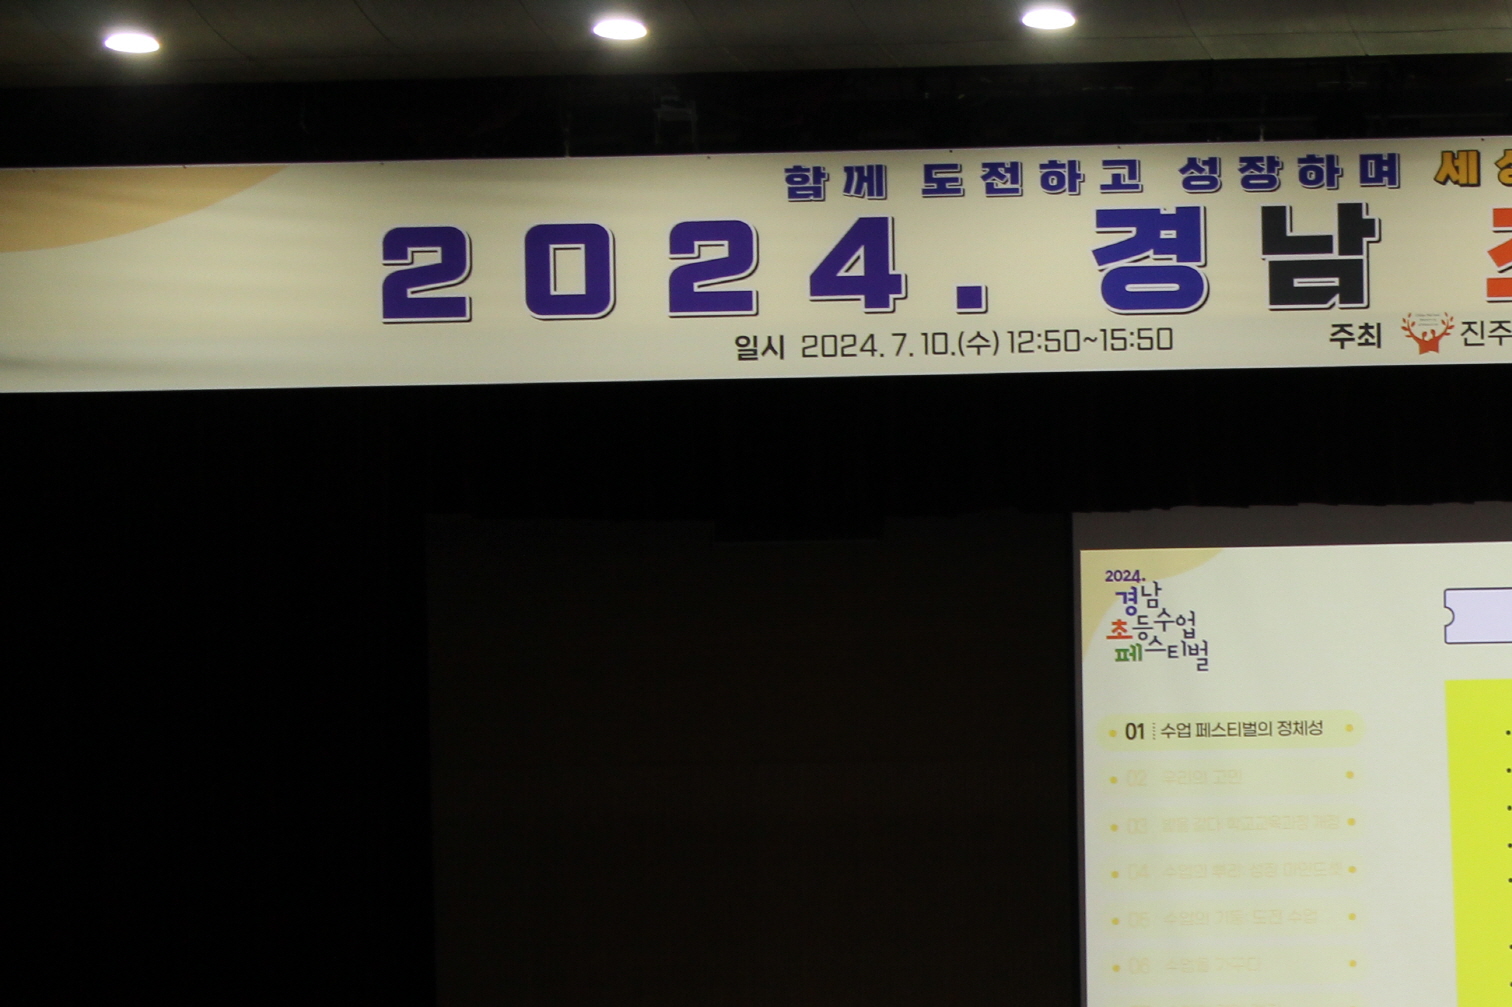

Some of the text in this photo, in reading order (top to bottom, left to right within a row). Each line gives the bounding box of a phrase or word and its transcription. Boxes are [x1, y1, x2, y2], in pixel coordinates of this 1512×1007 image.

[784, 164, 887, 202] 함께
[922, 159, 1143, 198] 도전하고
[1179, 153, 1400, 194] 성장하며
[382, 217, 988, 324] 2024.
[1092, 203, 1382, 315] 경남
[735, 335, 784, 361] 일시
[1007, 328, 1173, 353] 12:50~15:50
[1330, 323, 1381, 349] 주최
[1105, 569, 1146, 583] 2024.
[1115, 581, 1162, 616] 경남
[1114, 635, 1208, 671] 페스티벌
[1126, 720, 1322, 740] 01 수업 페스티벌의 정체성
